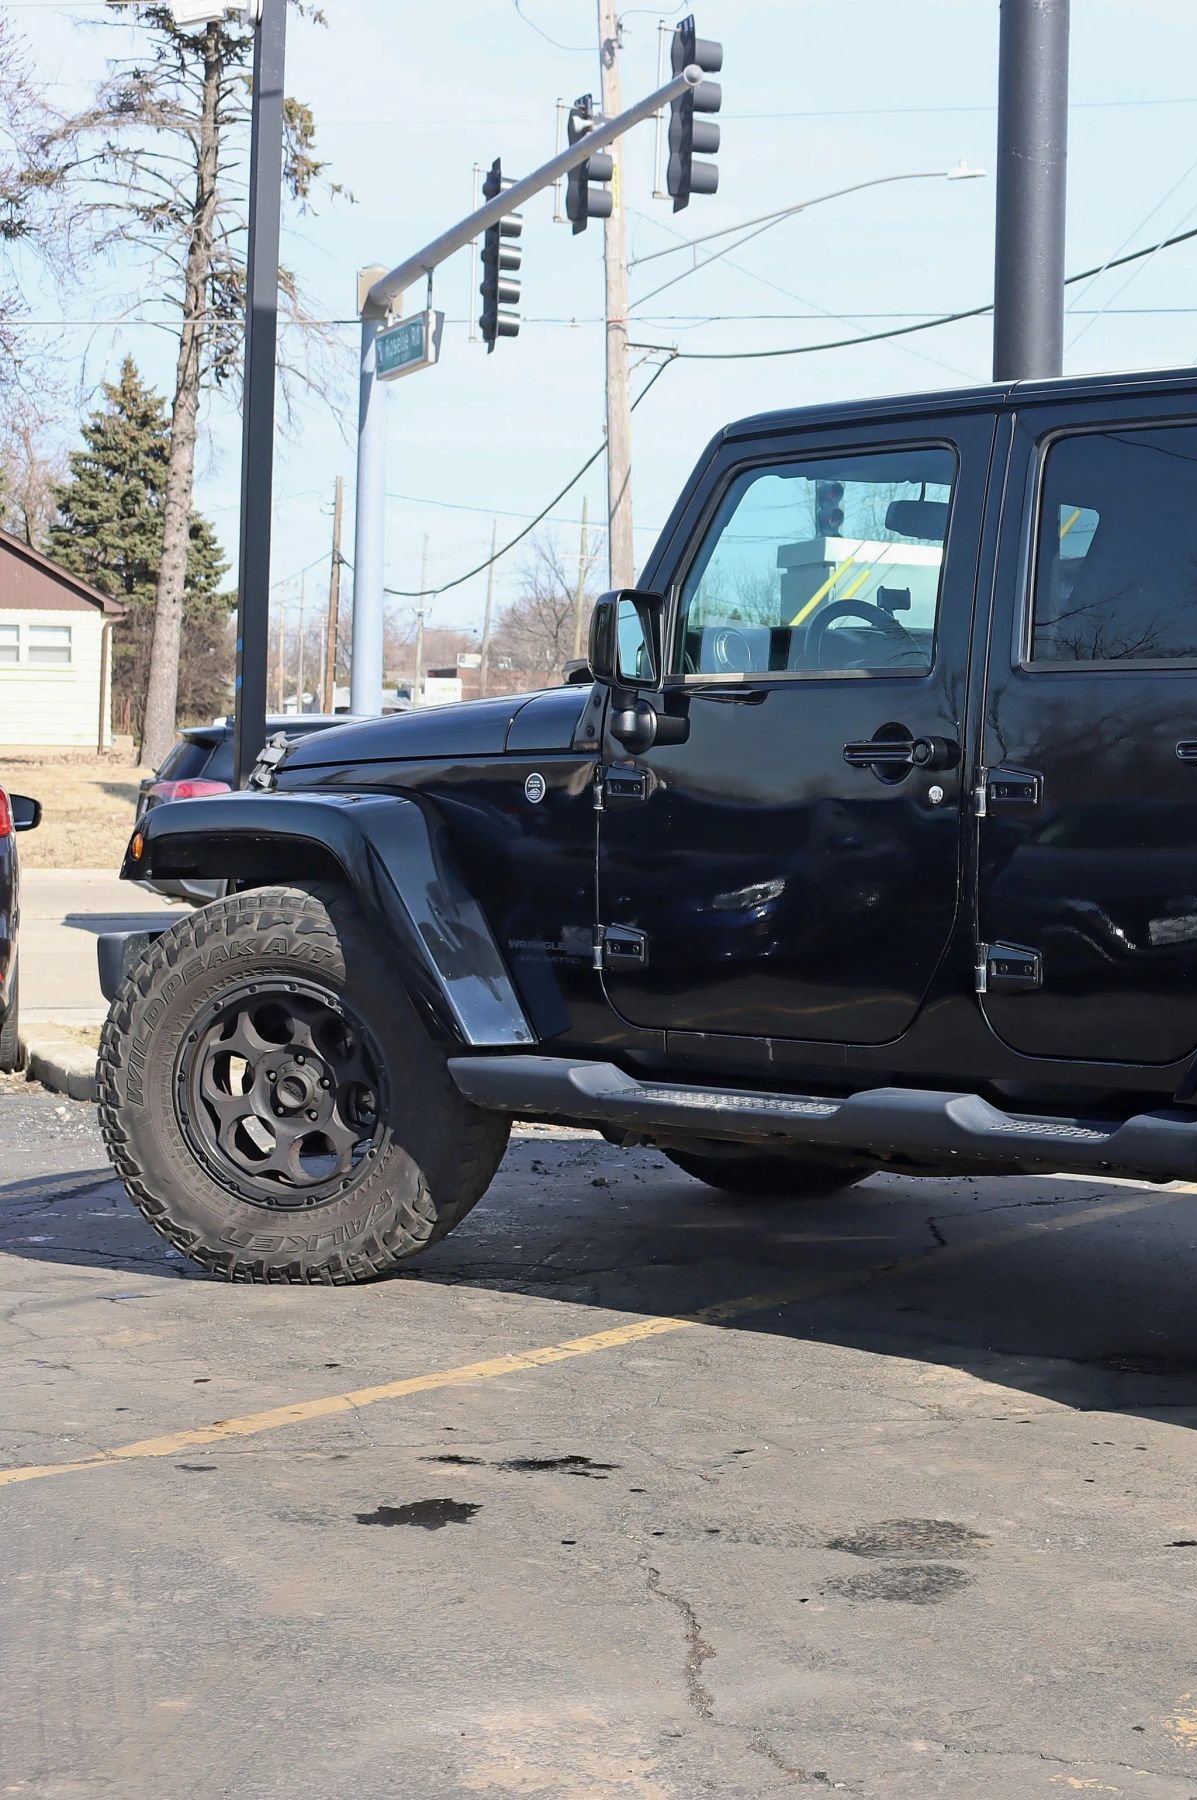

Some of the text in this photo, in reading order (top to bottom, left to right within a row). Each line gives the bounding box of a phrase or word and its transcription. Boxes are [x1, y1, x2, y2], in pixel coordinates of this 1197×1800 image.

[386, 331, 409, 358] Roselle
[411, 325, 421, 346] Rd
[126, 937, 334, 1107] WILDPEAK A/T
[219, 1189, 395, 1256] FALKEN
